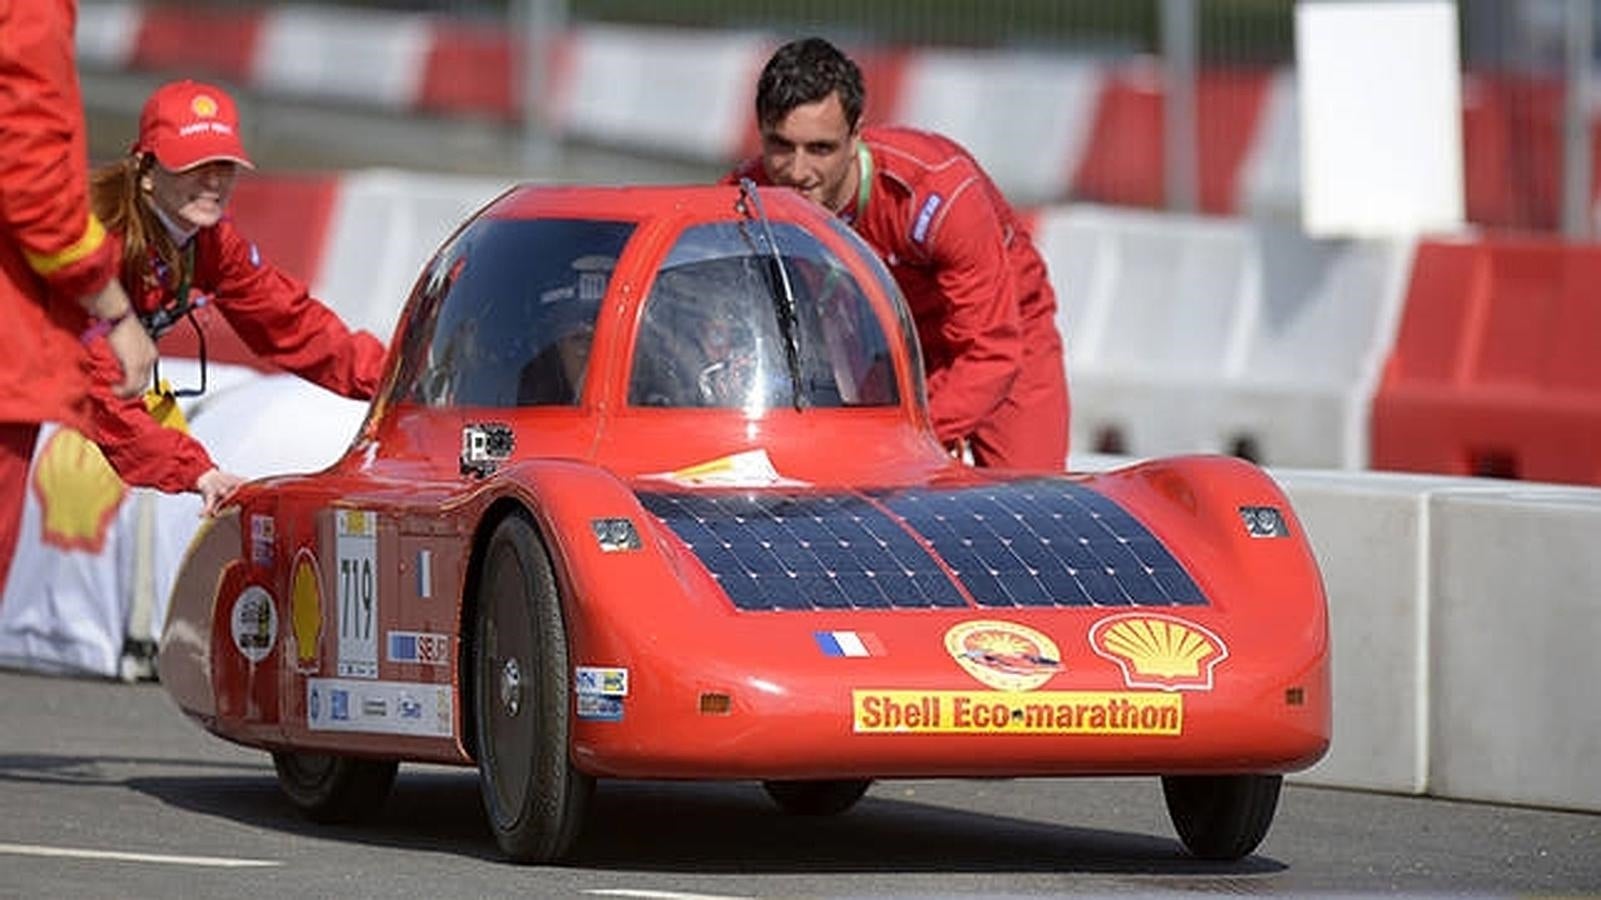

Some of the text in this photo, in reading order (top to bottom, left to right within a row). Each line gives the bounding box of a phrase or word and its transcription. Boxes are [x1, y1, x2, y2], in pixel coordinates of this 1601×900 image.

[341, 559, 373, 640] 719
[862, 696, 1178, 730] Shell Ecomarathon
